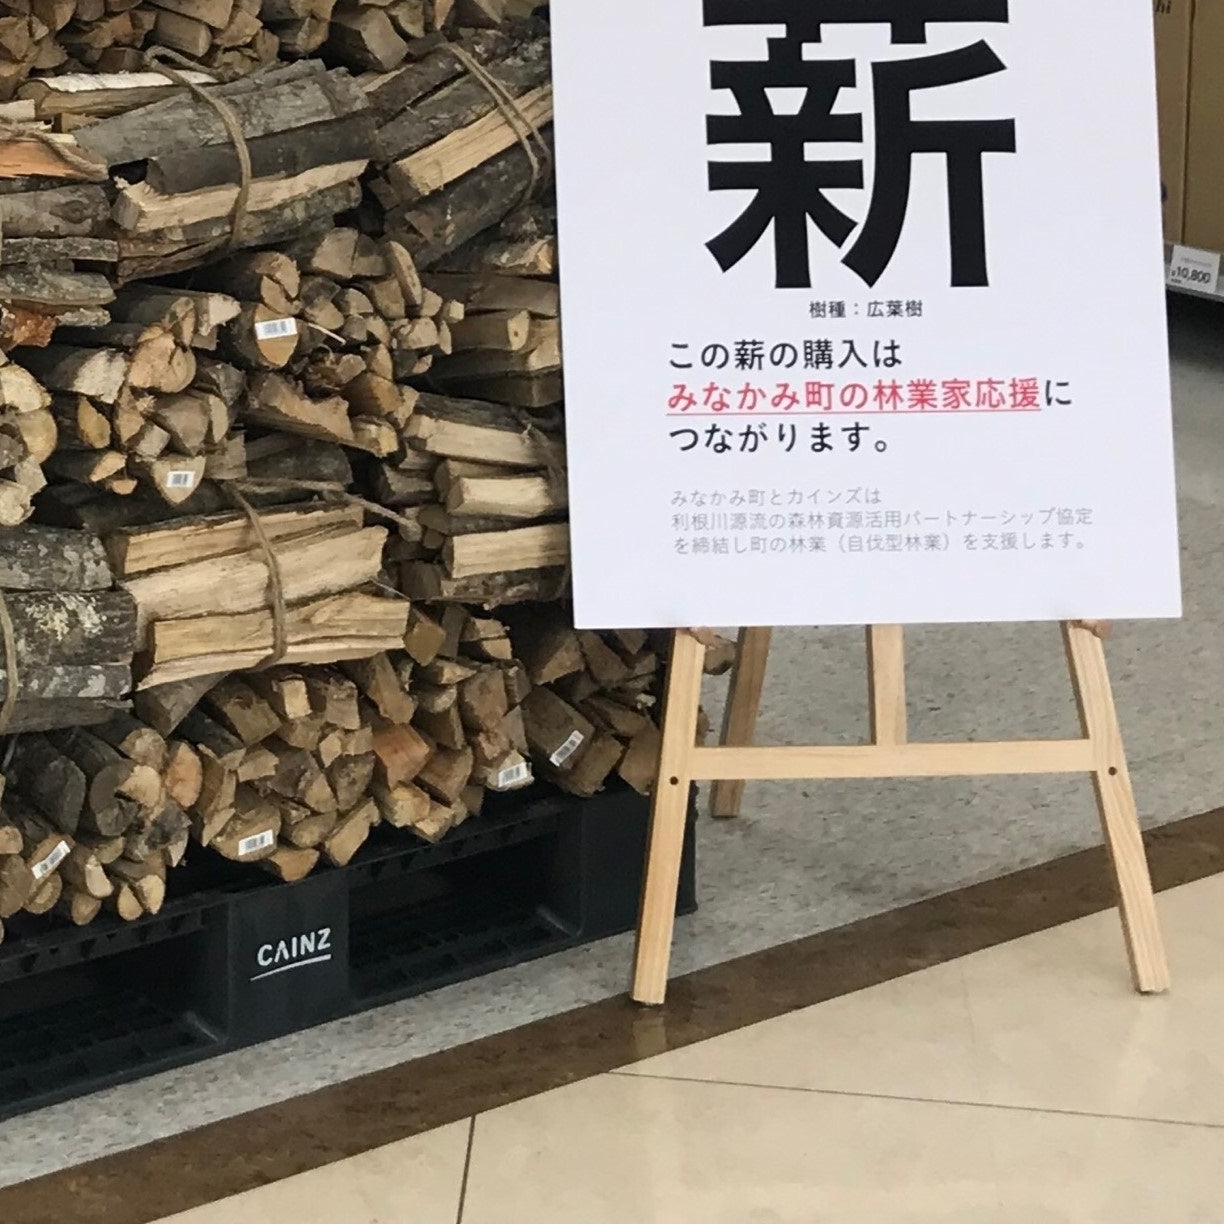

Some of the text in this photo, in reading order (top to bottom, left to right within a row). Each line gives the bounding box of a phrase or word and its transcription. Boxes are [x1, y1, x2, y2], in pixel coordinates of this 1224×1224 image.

[809, 299, 924, 319] 樹種：広葉樹
[669, 339, 903, 371] この薪の購入は
[667, 377, 1073, 413] みなかみ町の林業家応援に
[669, 422, 889, 454] つながります。
[671, 488, 882, 507] みなかみ町とカインズは
[672, 507, 1094, 531] 利根川源流の森林資源活用パートナーシップ協定
[256, 928, 332, 968] CAINZ
